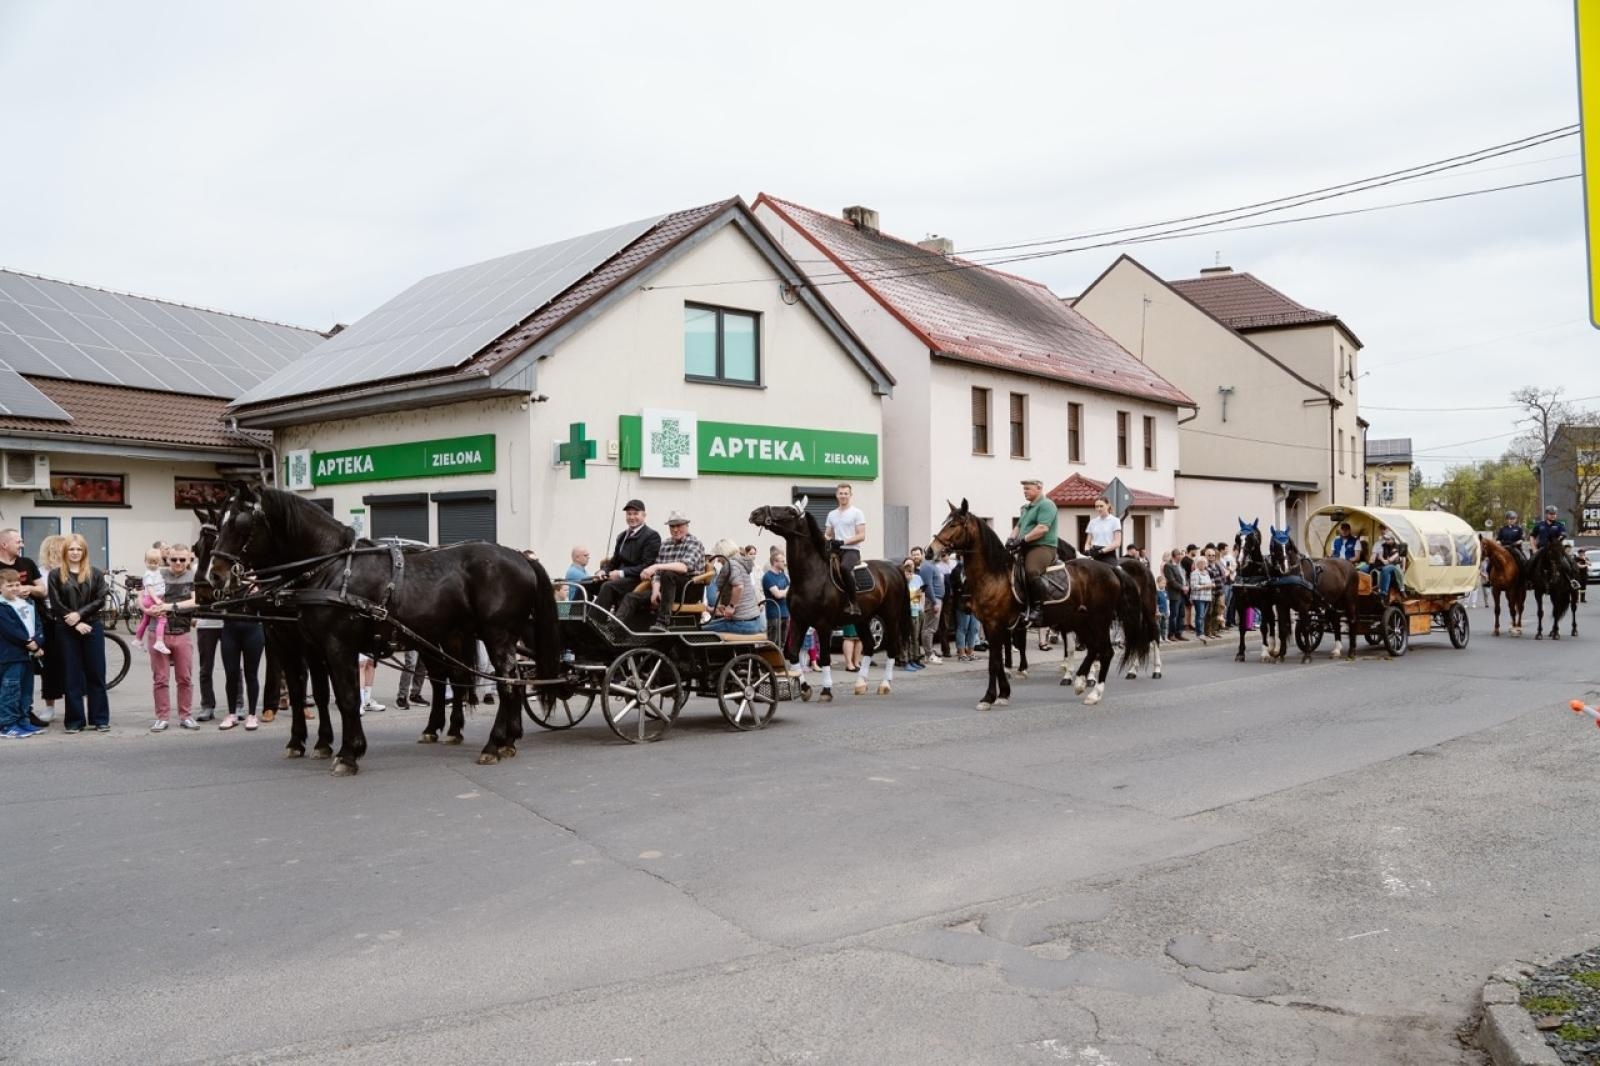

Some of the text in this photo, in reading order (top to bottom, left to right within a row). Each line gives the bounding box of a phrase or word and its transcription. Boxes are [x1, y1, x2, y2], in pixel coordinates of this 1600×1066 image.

[316, 450, 482, 477] APTEKA ZIELONA
[709, 436, 869, 465] APTEKA ZIELONA
